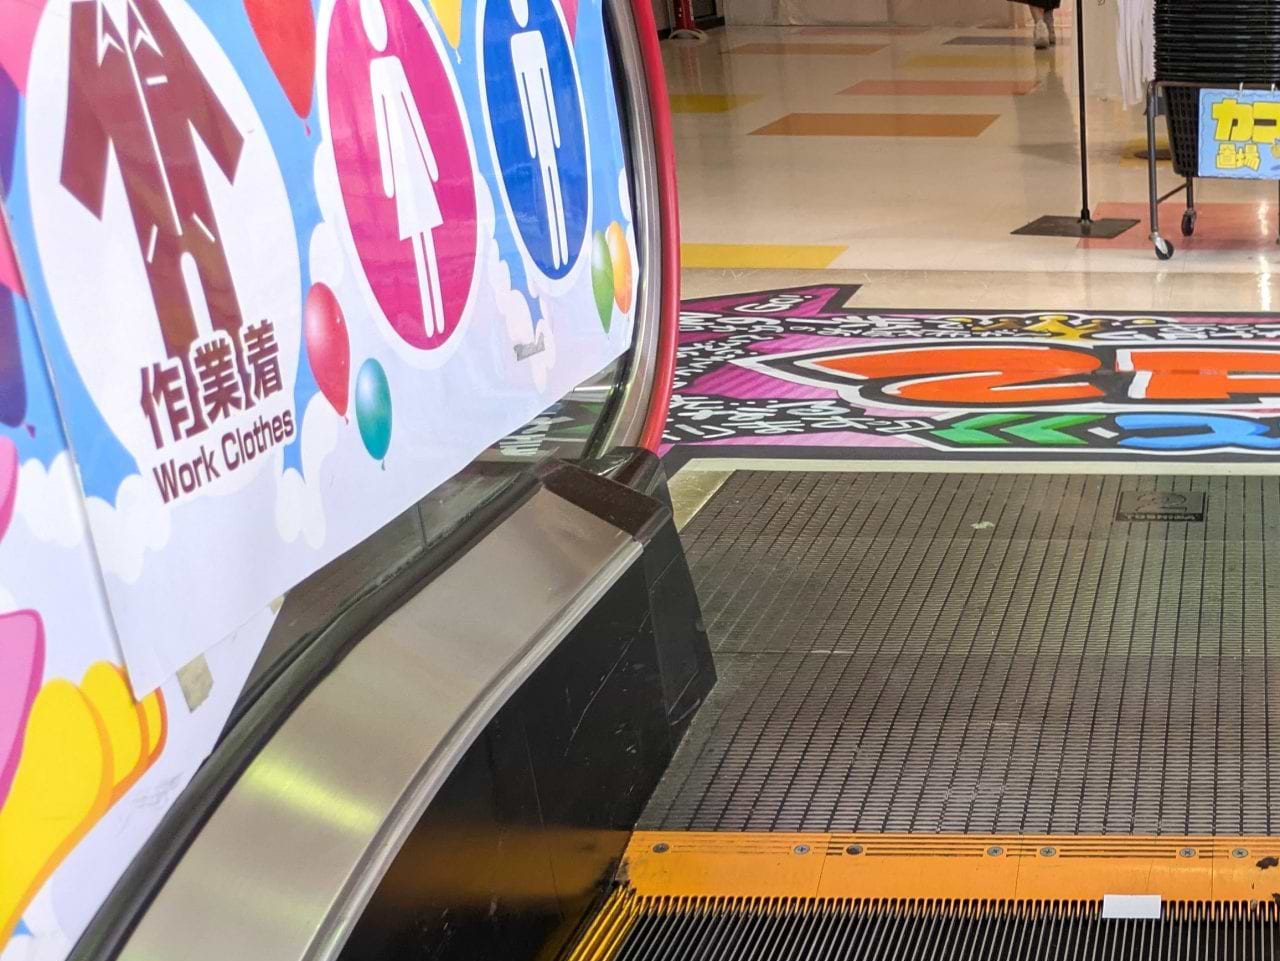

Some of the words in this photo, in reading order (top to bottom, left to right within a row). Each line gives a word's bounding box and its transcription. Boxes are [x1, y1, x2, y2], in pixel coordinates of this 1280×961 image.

[140, 318, 283, 450] 作業着
[152, 445, 221, 504] Work
[221, 409, 294, 472] Clothes
